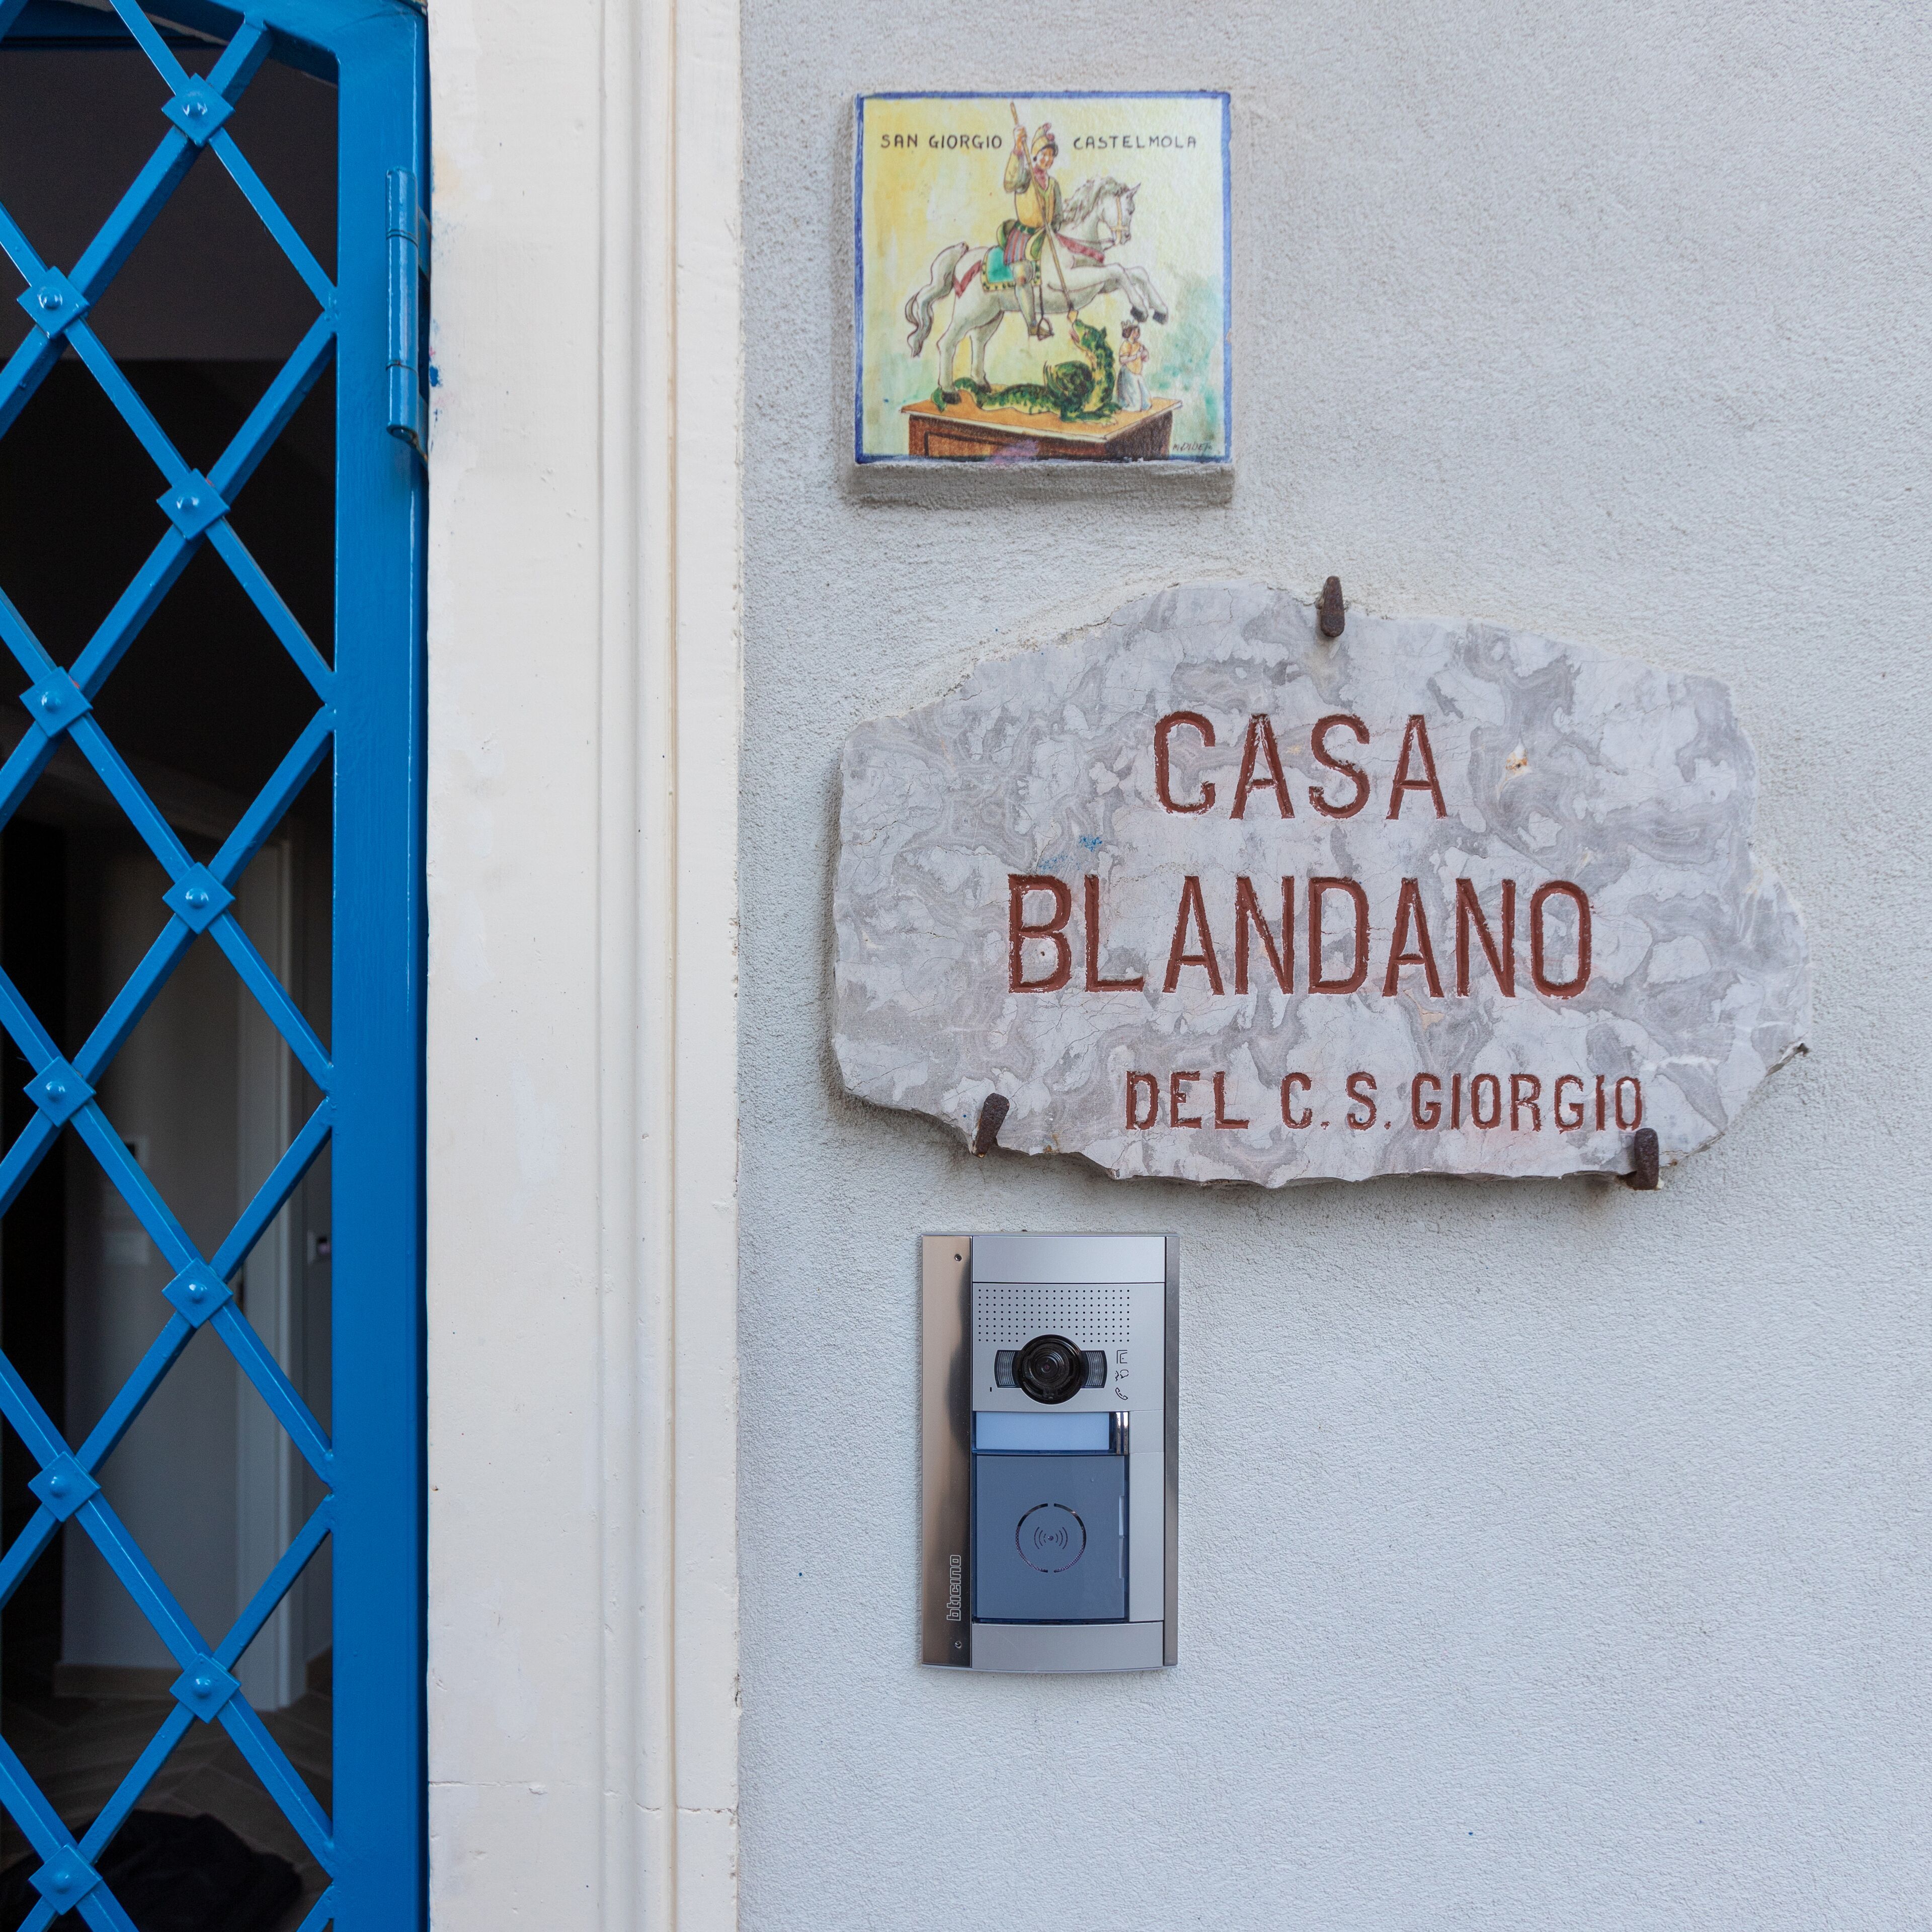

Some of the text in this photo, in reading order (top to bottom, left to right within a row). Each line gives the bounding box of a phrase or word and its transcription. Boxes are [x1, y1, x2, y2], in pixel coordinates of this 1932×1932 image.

[880, 133, 1003, 150] SAN GIORGIO
[1072, 134, 1197, 151] CASTELMOLA
[1154, 710, 1448, 820] CASA
[1007, 873, 1593, 1000] BLANDANO
[1125, 1071, 1250, 1131] DEL
[946, 1554, 961, 1622] bticino
